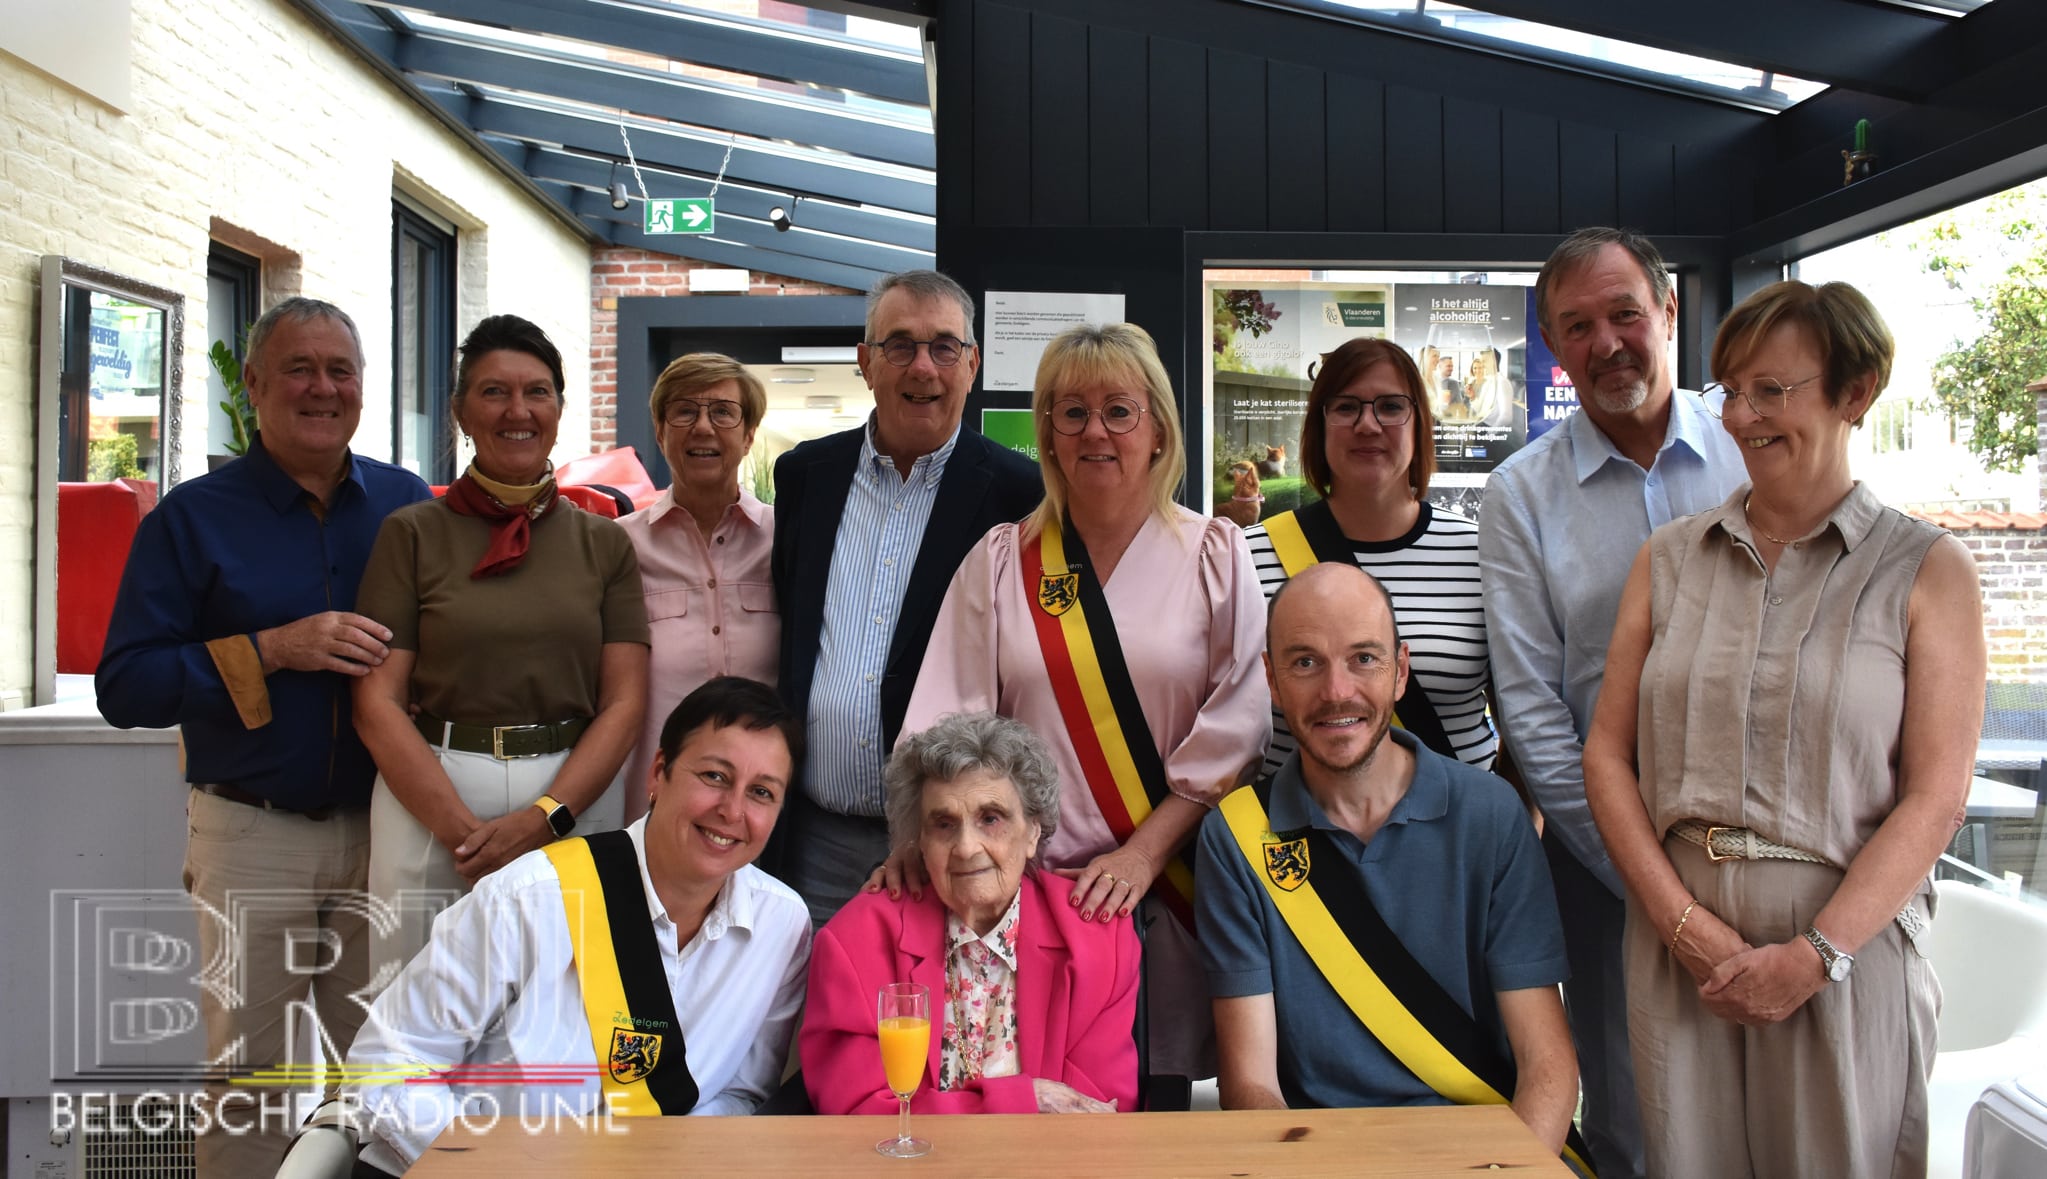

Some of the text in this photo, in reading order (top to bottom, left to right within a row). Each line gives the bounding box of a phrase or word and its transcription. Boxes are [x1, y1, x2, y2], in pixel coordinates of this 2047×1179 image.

[1431, 298, 1489, 311] Is het altijd
[1343, 308, 1381, 316] Vlaanderen
[1429, 311, 1491, 323] alcoholtijd?
[1545, 386, 1576, 401] EEN
[1233, 399, 1250, 407] Laat
[1250, 399, 1259, 408] je
[1260, 399, 1273, 407] kat
[1543, 405, 1581, 420] NAC
[1443, 433, 1468, 441] dichtbij
[1477, 434, 1508, 442] bekijken?
[612, 1010, 669, 1029] Zedelgem
